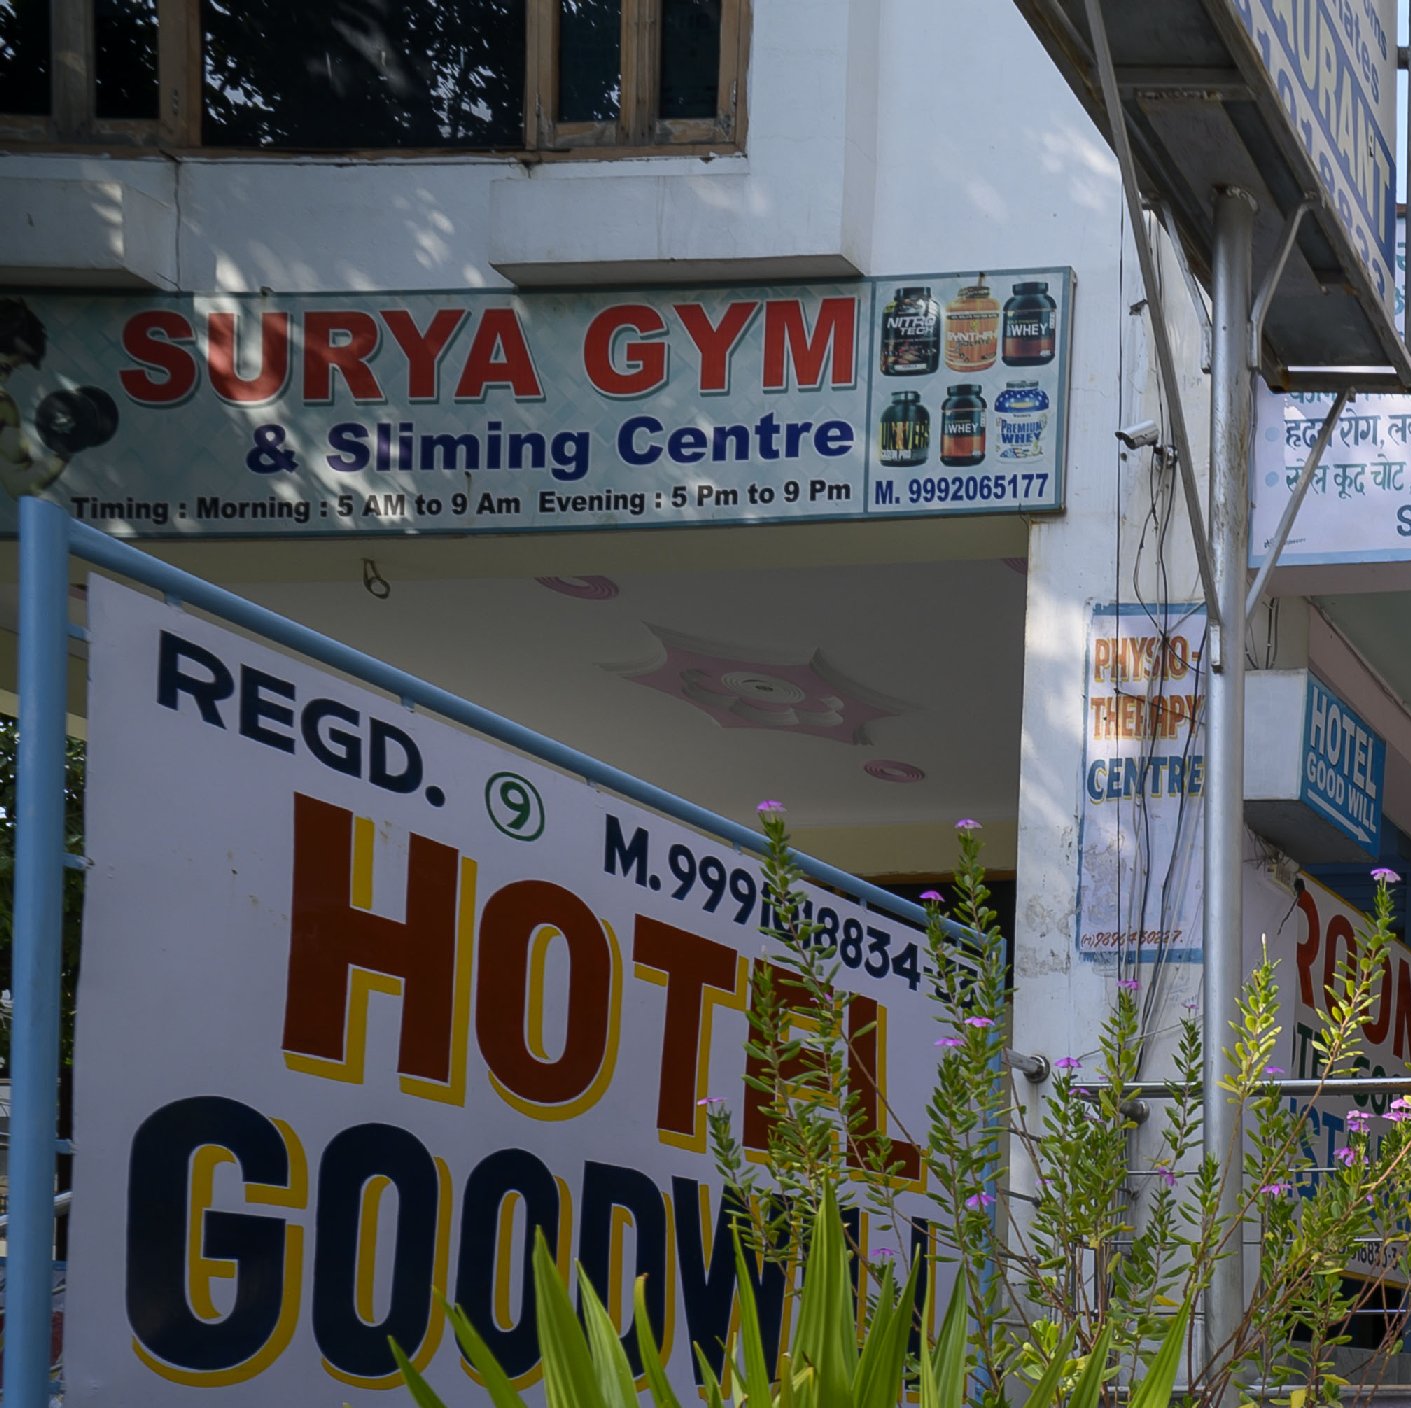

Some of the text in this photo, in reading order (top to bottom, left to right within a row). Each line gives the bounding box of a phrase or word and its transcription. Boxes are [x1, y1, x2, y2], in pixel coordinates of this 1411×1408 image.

[119, 296, 858, 405] SURYA GYM
[1010, 324, 1048, 337] WHEY
[246, 412, 855, 482] & Sliming Centre
[948, 422, 978, 433] WHEY
[1001, 420, 1043, 432] PREMIUM
[1001, 432, 1042, 444] WHEY
[71, 496, 169, 525] Timing
[196, 496, 310, 524] Morning
[338, 494, 353, 517] 5
[361, 494, 405, 516] AM
[415, 496, 442, 516] to
[451, 493, 467, 515] 9
[477, 493, 520, 515] Am
[539, 488, 645, 516] Evening
[671, 485, 687, 508] 5
[697, 485, 738, 507] Pm
[748, 484, 774, 506] to
[783, 481, 799, 503] 9
[809, 480, 851, 502] Pm
[874, 473, 1049, 505] M. 9992065177
[156, 628, 448, 809] REGD.
[1091, 695, 1204, 741] THERAPY
[1310, 685, 1377, 800] HOTEL
[1087, 754, 1204, 805] CENTRE
[1306, 751, 1345, 806] GOOD
[1347, 783, 1377, 834] WILL
[283, 791, 928, 1194] HOTEL
